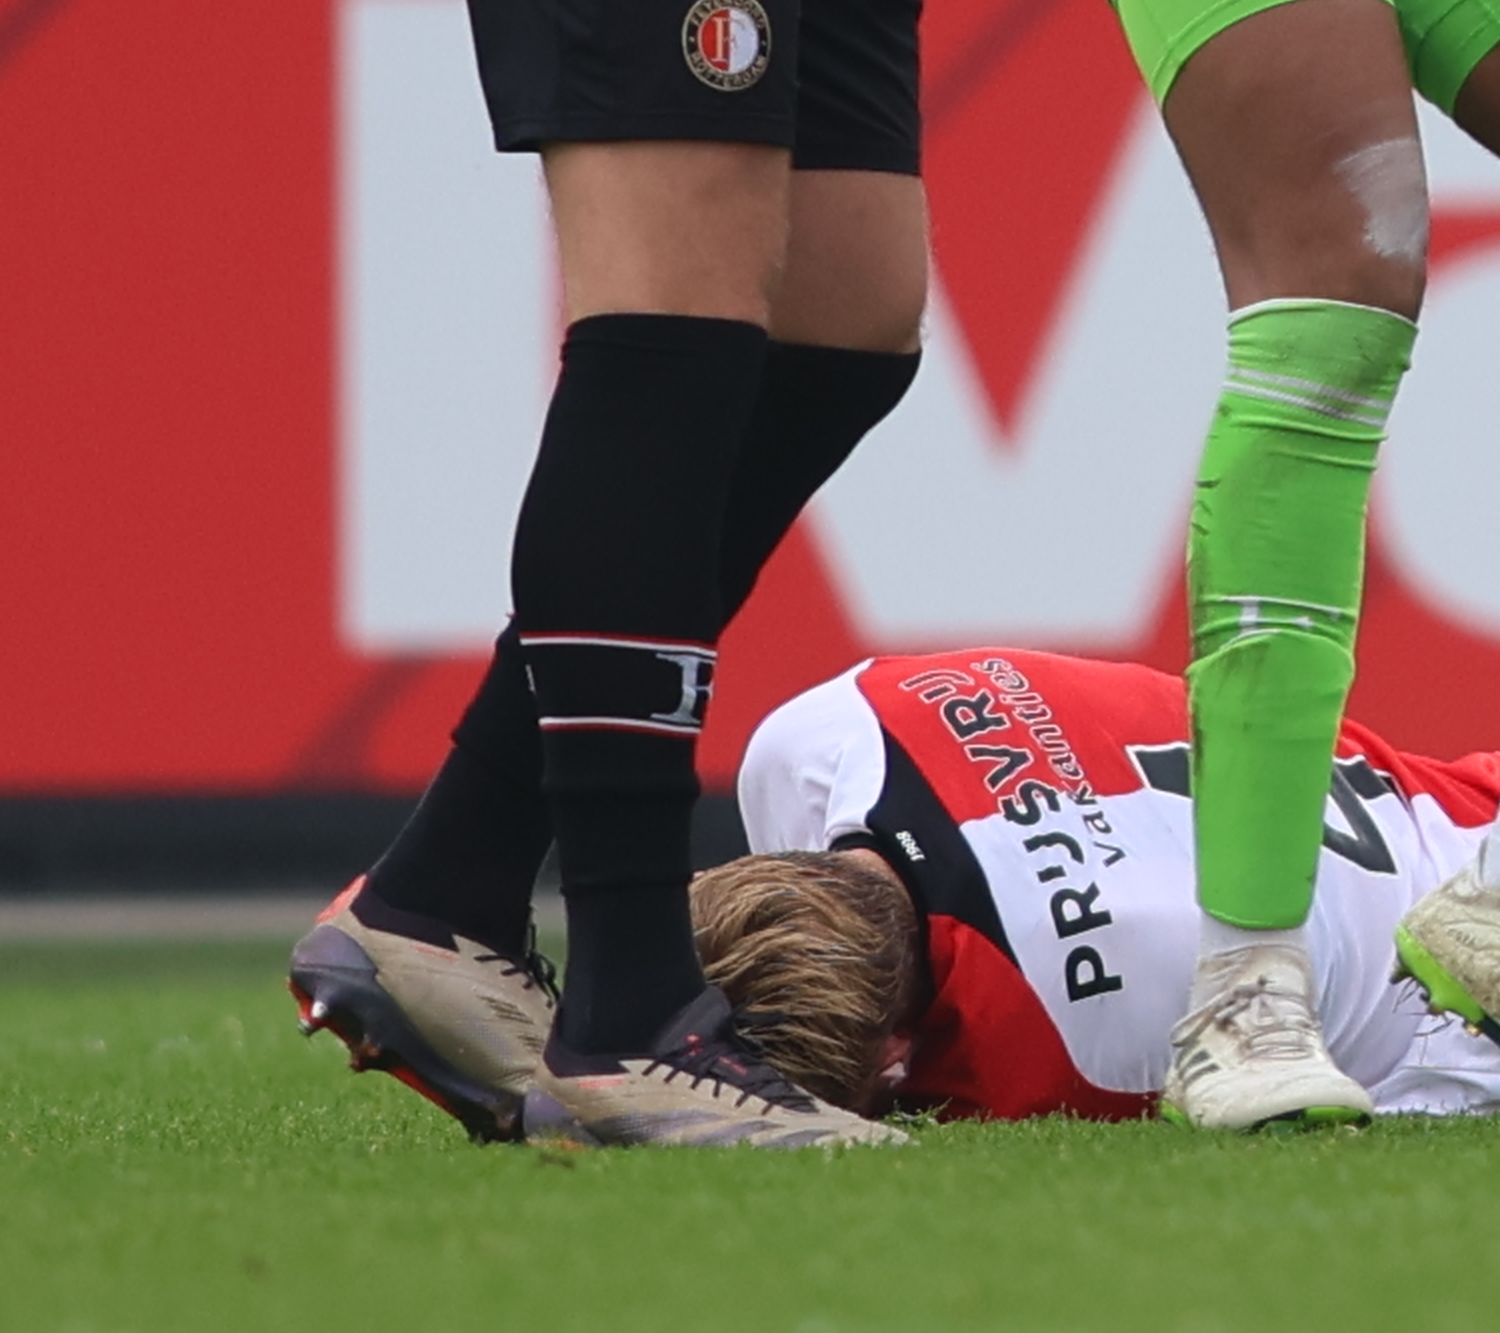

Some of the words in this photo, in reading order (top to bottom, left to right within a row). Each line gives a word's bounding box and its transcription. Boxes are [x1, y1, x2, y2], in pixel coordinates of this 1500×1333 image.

[894, 829, 927, 863] 1908
[898, 669, 1124, 1004] PRIJSVRIJ
[970, 656, 1127, 869] vakanties
